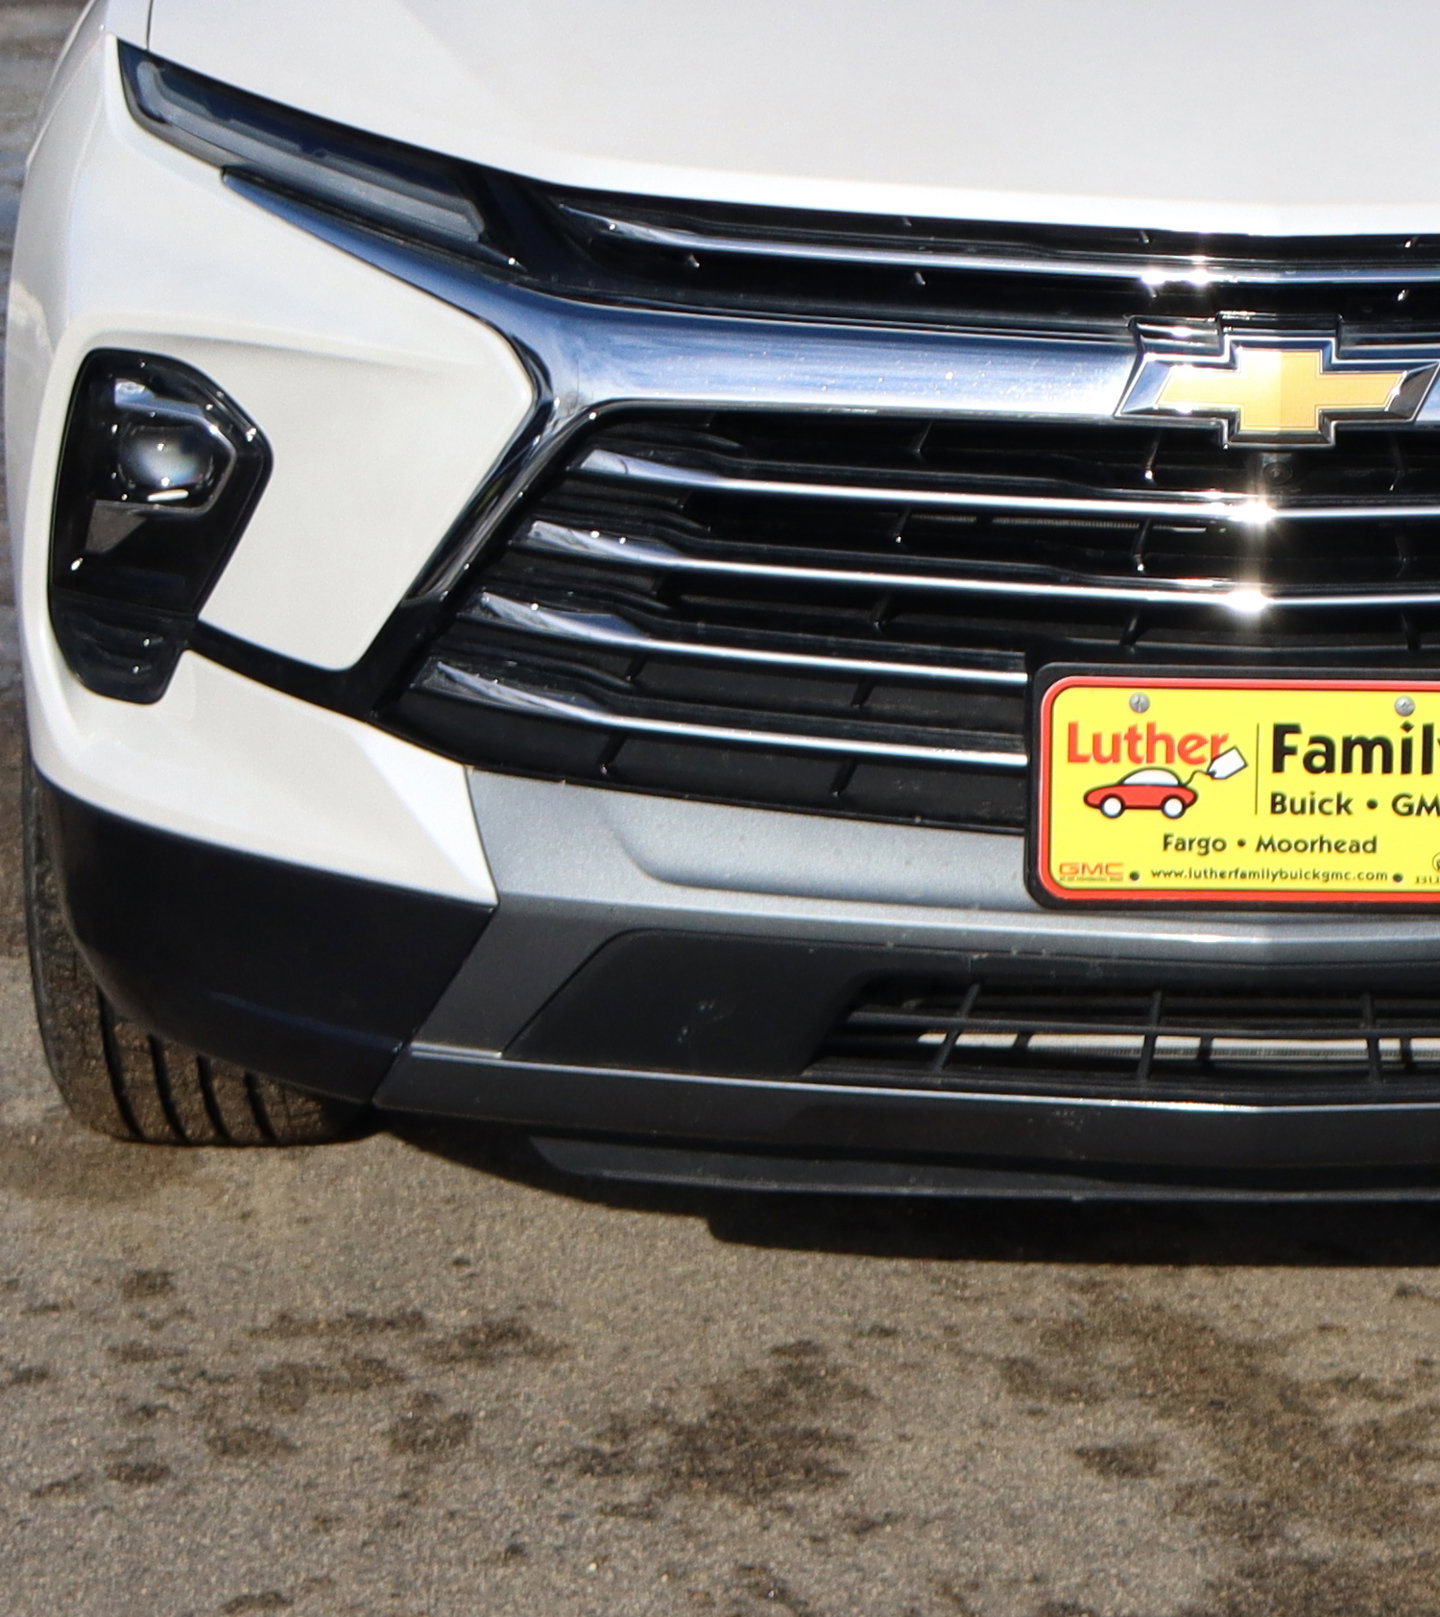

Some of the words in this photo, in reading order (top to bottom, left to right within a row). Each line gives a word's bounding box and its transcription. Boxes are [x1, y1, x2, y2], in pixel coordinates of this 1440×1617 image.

[1067, 721, 1230, 766] Luther
[1270, 791, 1354, 816] Buick
[1162, 833, 1228, 857] Fargo
[1255, 834, 1378, 854] Moorhead
[1059, 861, 1124, 877] GMC
[1151, 866, 1388, 883] www.lutherfamilybuickgmc.com
